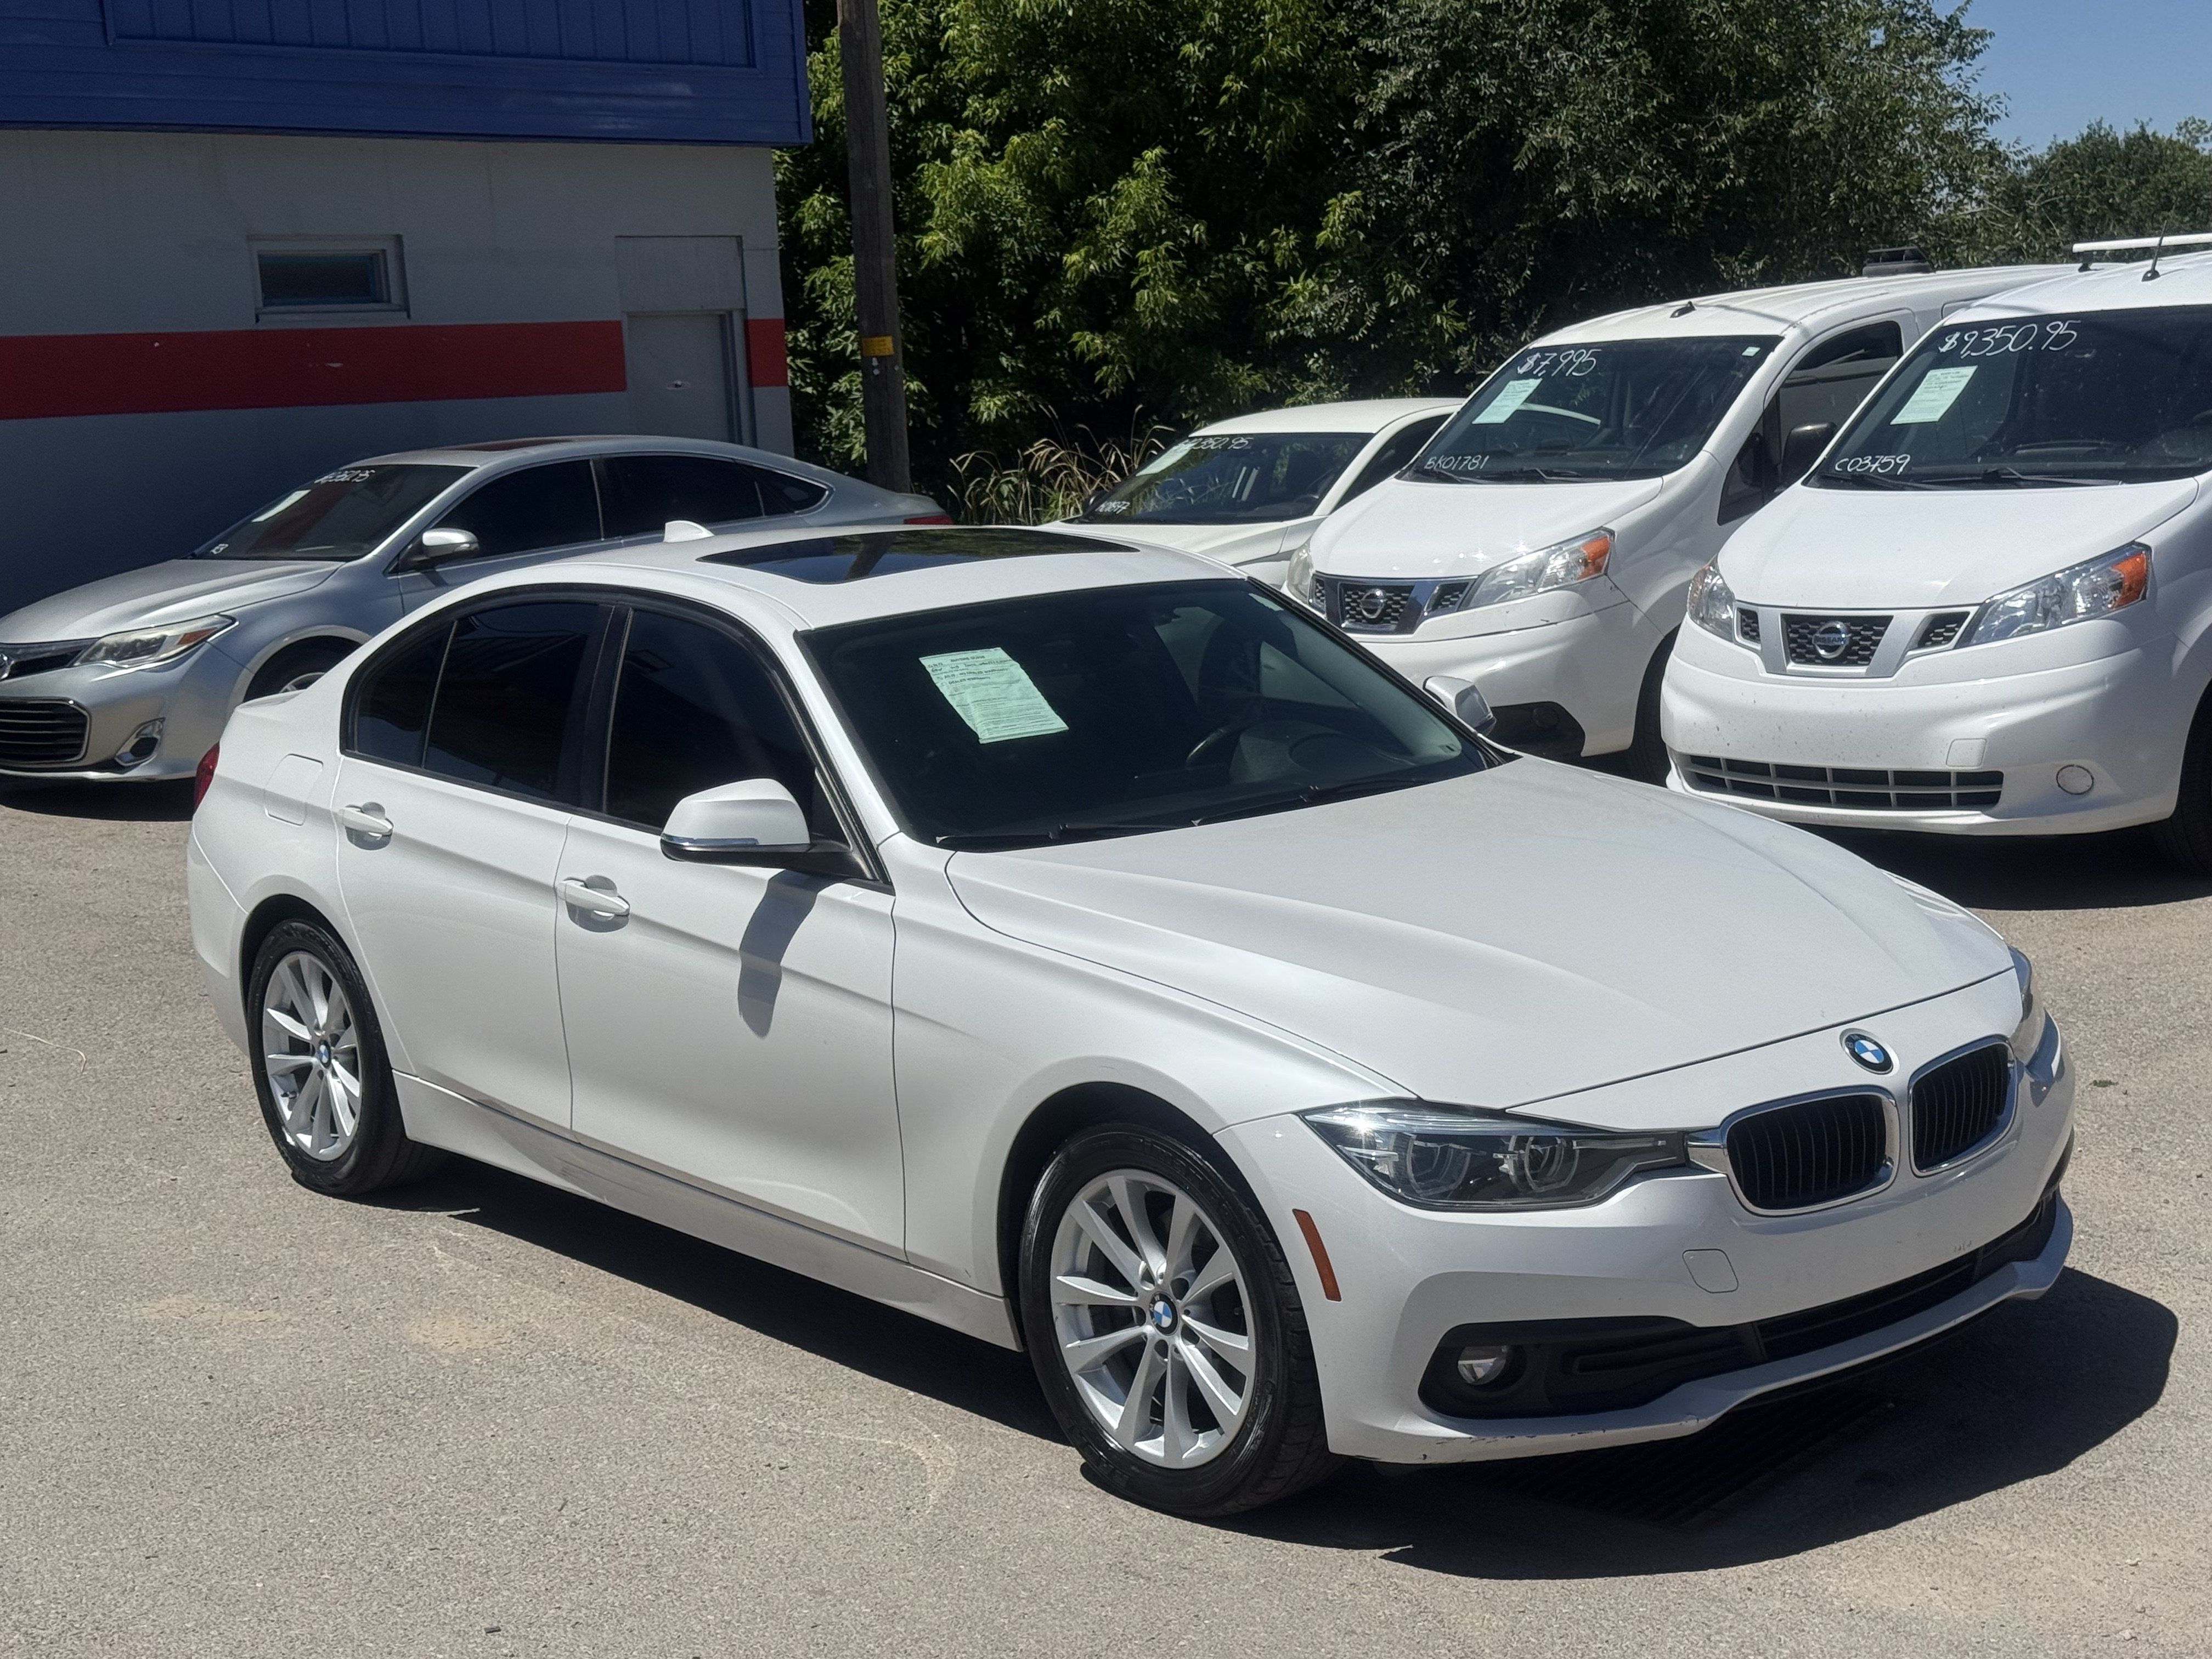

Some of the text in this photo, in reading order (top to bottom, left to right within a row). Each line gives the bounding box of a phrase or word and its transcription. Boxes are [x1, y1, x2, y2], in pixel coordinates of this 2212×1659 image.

[1938, 320, 2081, 359] $9,350.95
[1517, 349, 1602, 377] $7,995
[1835, 453, 1911, 476] C03759
